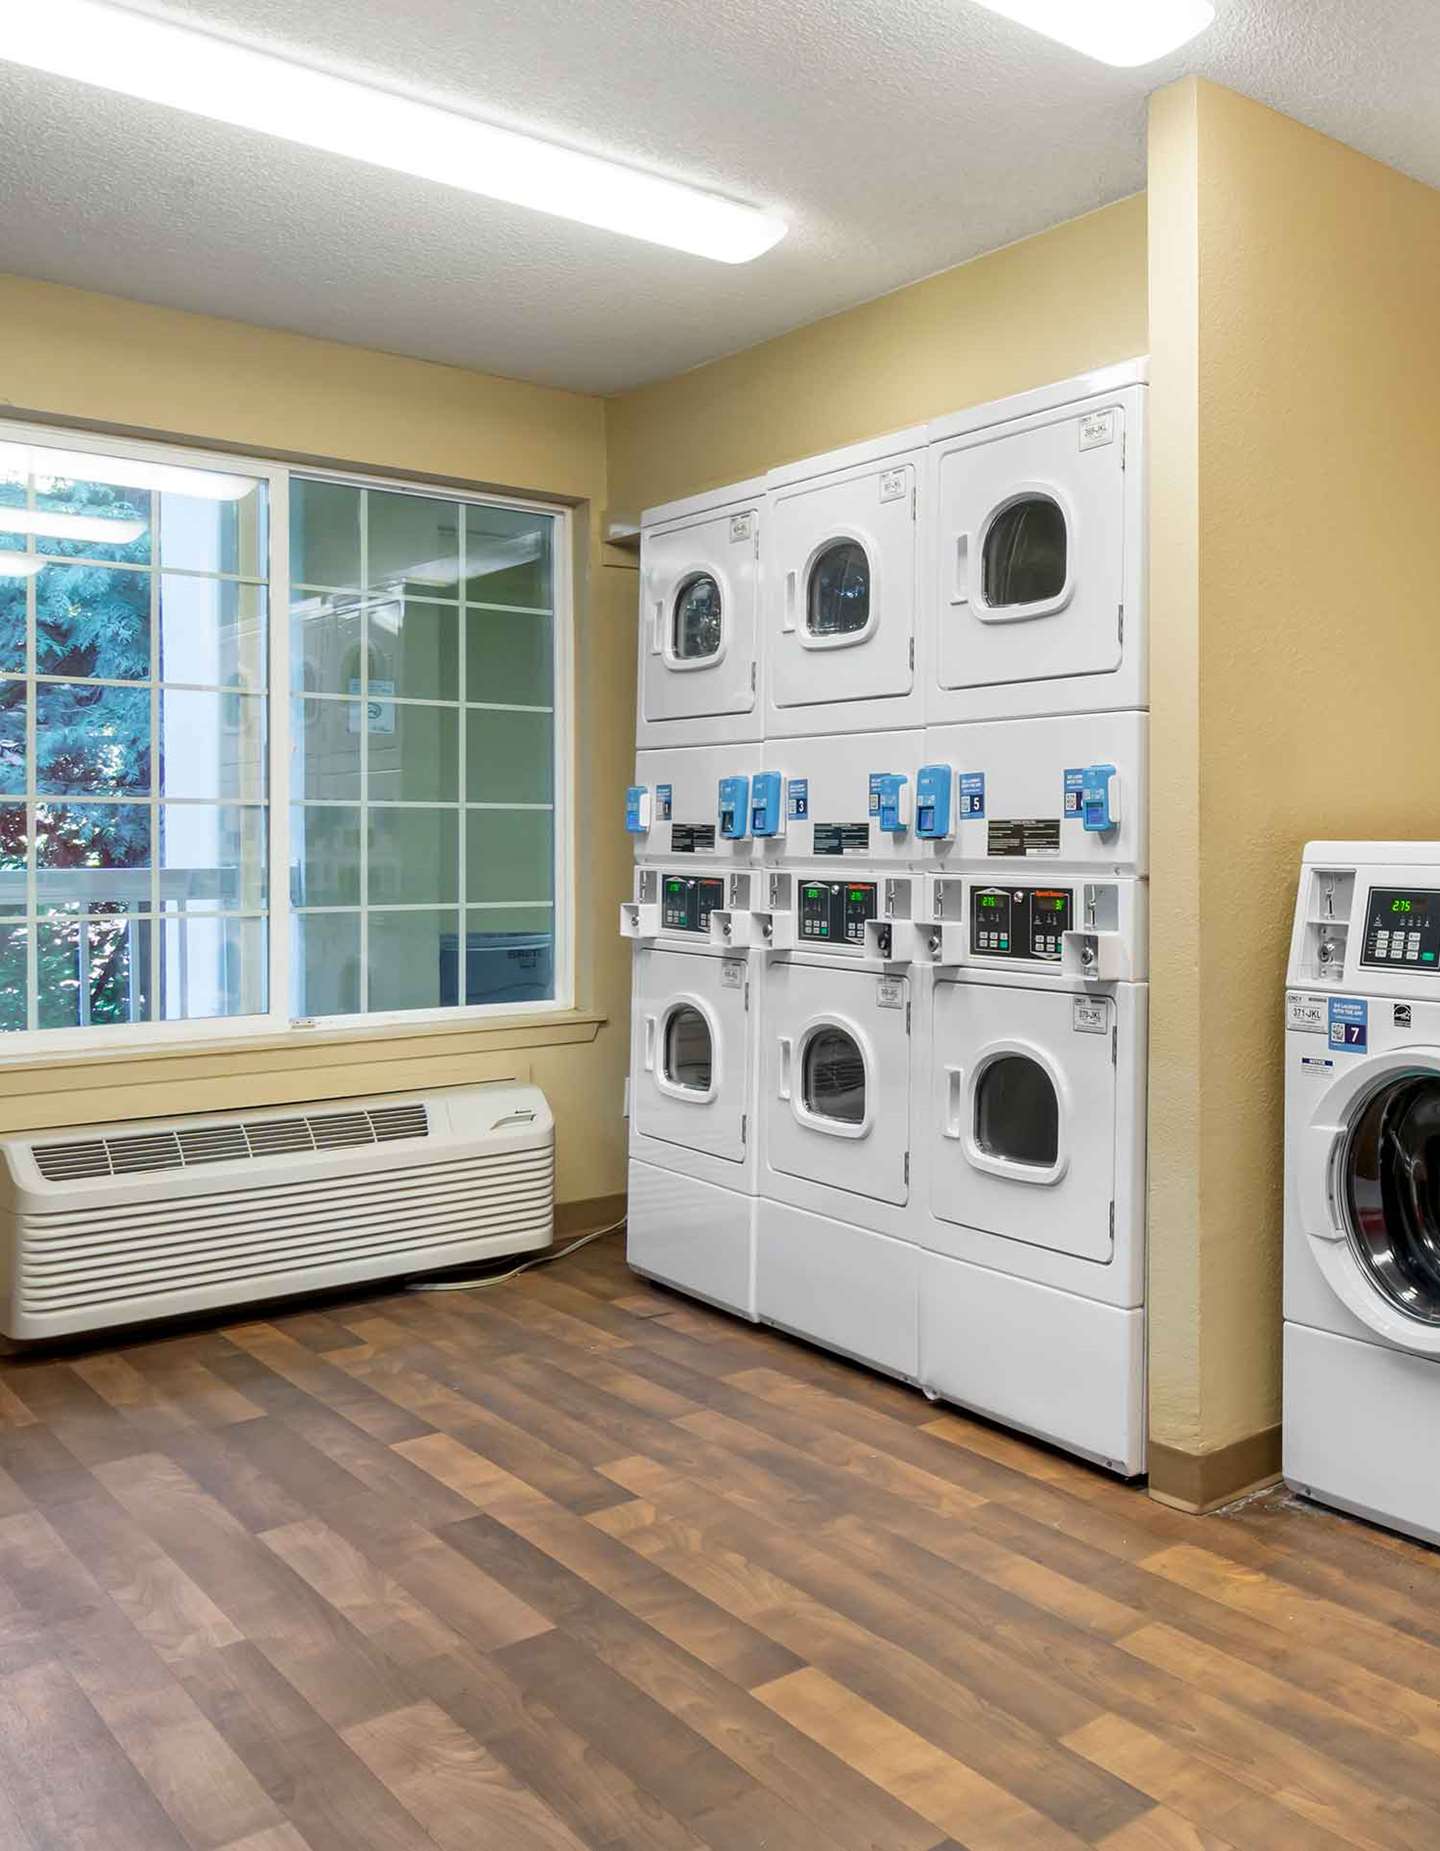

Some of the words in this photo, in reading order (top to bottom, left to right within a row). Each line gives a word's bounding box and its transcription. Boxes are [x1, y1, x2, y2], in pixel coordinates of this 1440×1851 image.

[798, 800, 804, 812] 3
[973, 797, 980, 810] 5
[1350, 1026, 1360, 1043] 7
